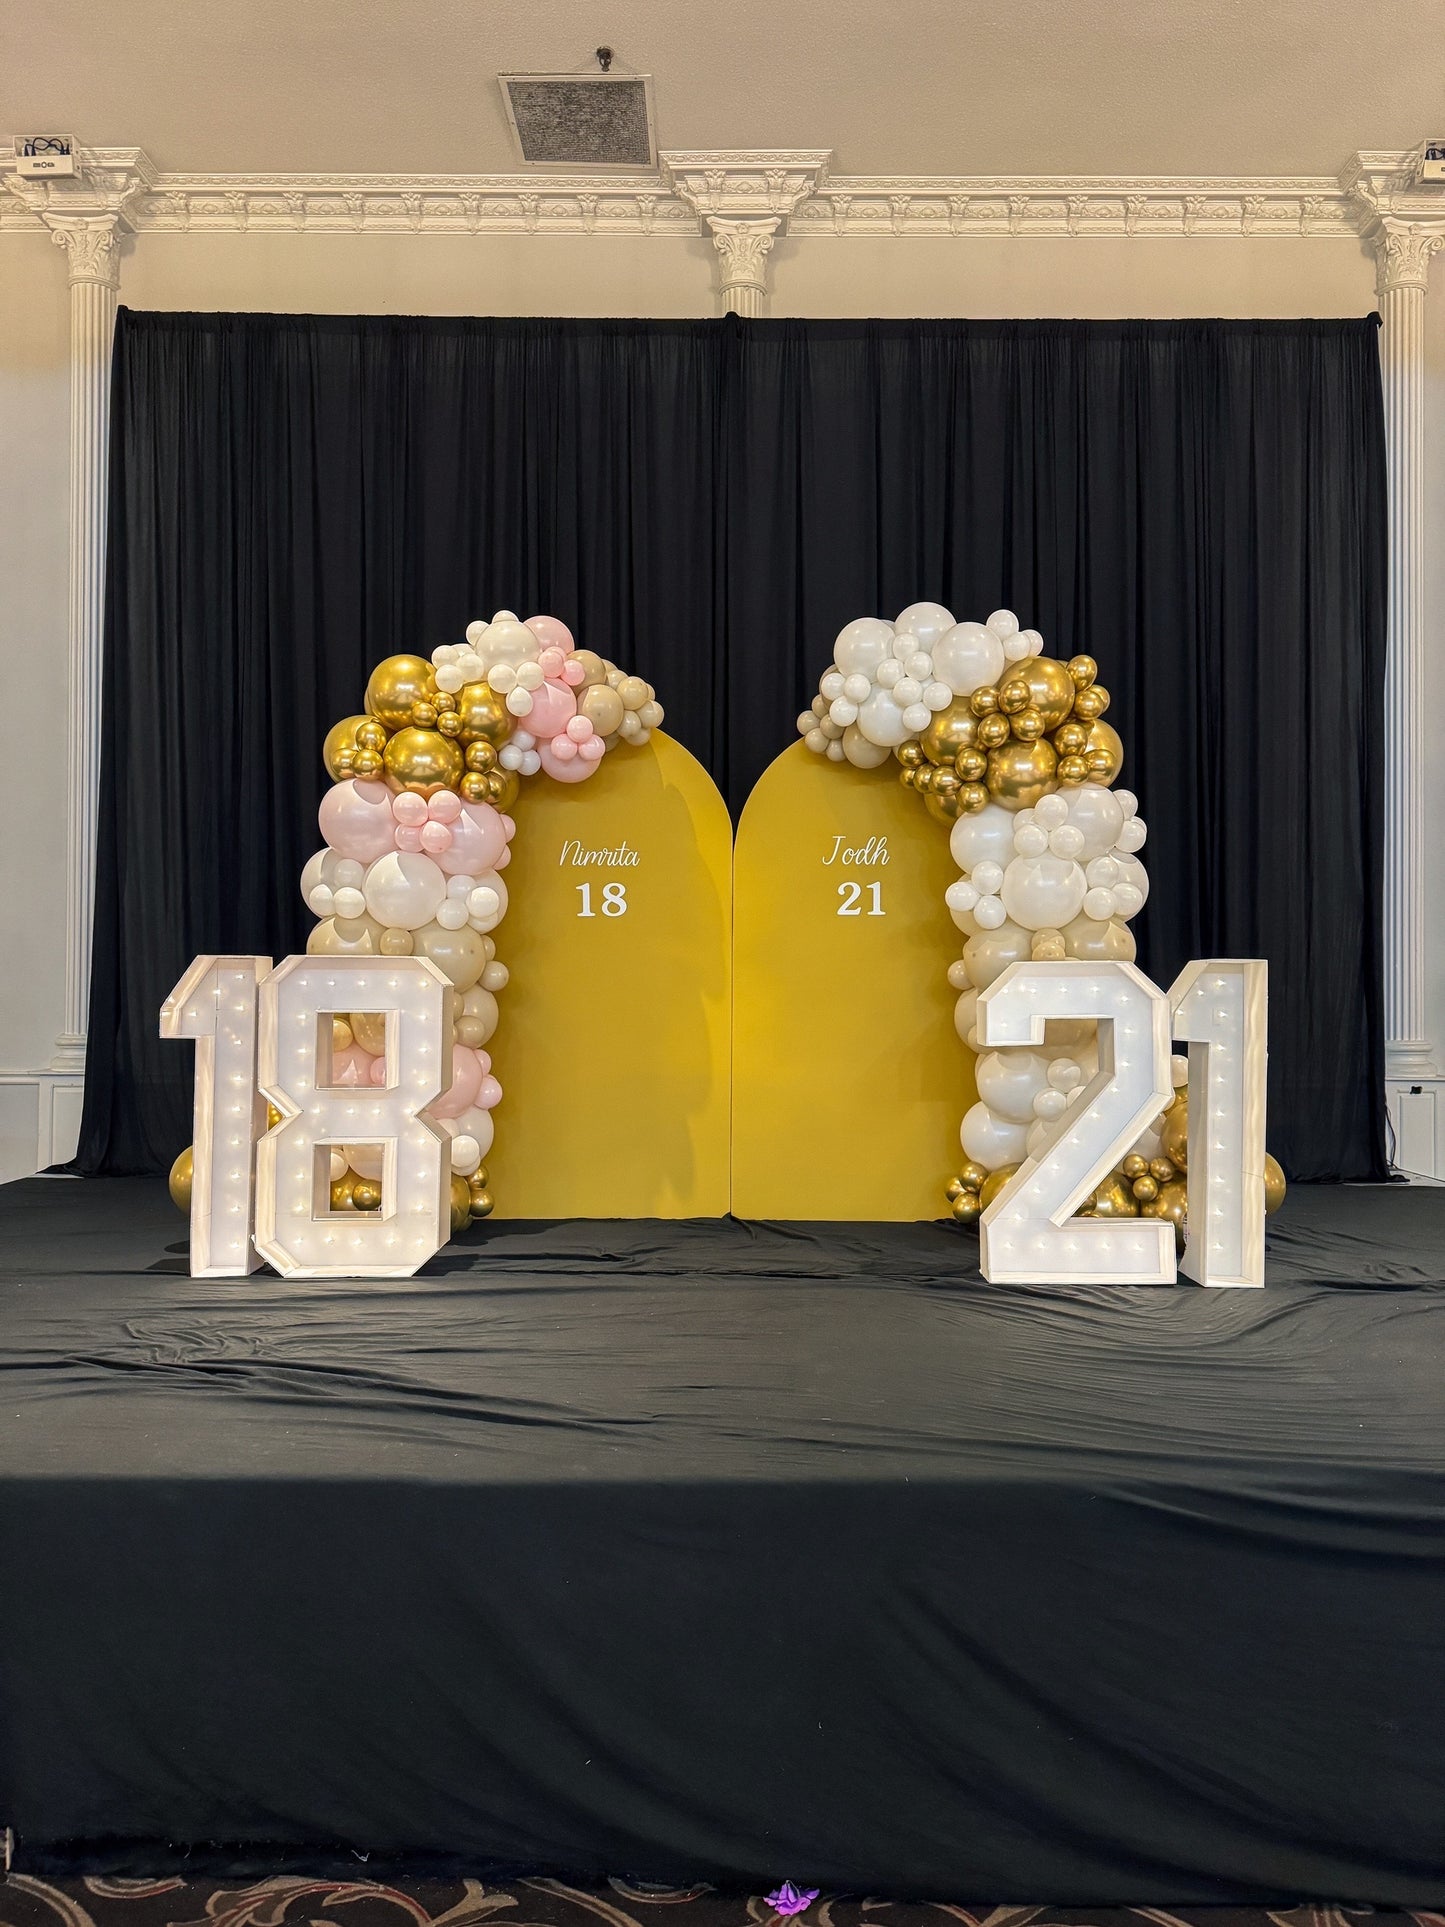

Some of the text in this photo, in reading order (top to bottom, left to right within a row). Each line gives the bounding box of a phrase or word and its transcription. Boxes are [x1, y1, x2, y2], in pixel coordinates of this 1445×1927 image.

[559, 840, 641, 867] Nimrita
[822, 835, 890, 866] Jodh
[575, 882, 628, 917] 18
[837, 881, 886, 916] 21
[160, 955, 454, 1277] 18
[977, 959, 1268, 1288] 21
